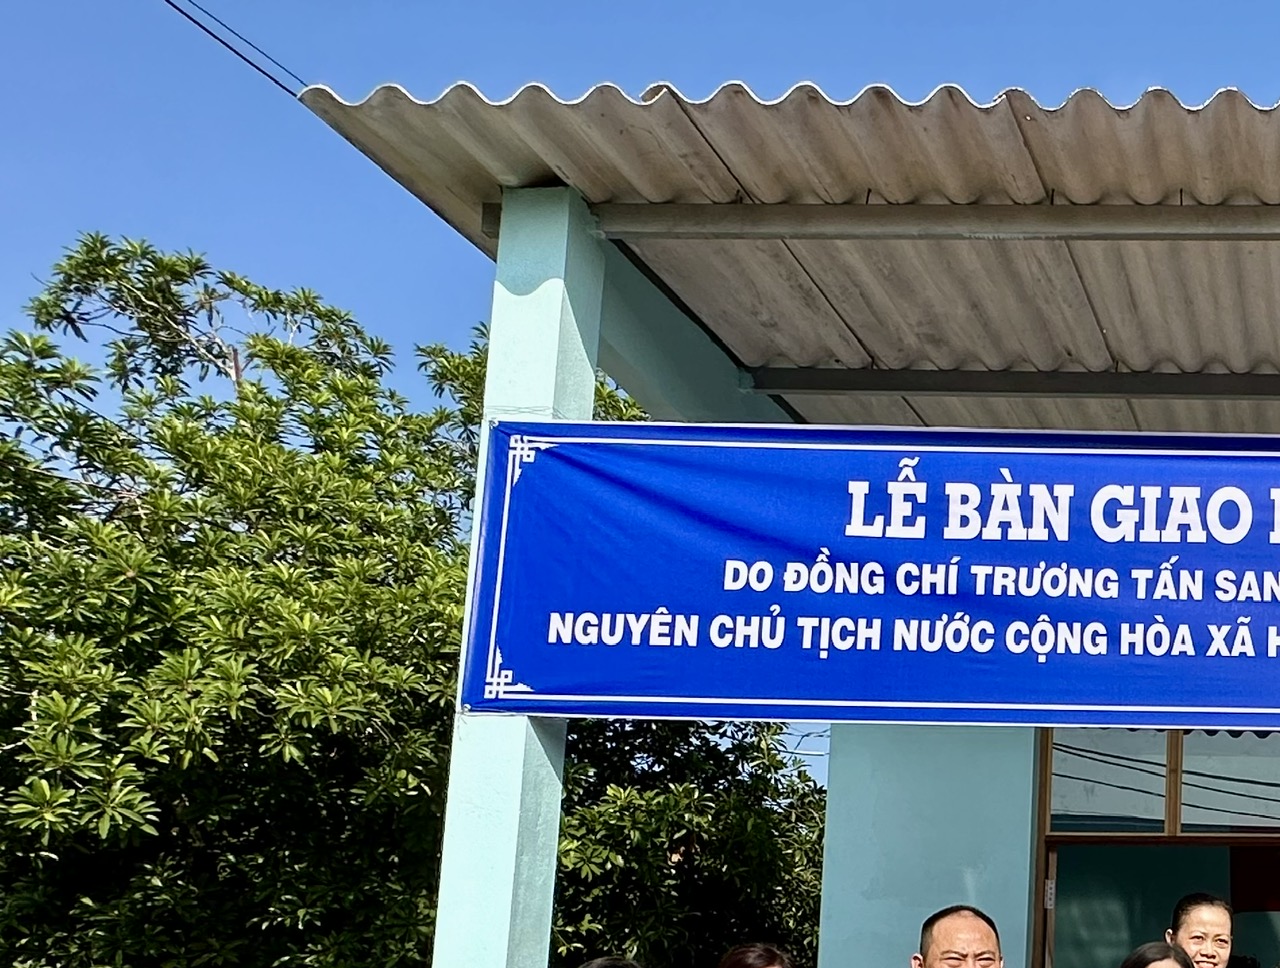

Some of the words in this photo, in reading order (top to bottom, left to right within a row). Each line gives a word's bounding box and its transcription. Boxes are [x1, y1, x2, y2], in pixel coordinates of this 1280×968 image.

[845, 456, 928, 539] LỄ
[943, 467, 1074, 542] BÀN
[1090, 484, 1254, 545] GIAO
[724, 560, 773, 592] DO
[783, 547, 886, 596] ĐỒNG
[896, 556, 960, 596] CHÍ
[971, 561, 1120, 599] TRƯƠNG
[1131, 555, 1205, 601] TẤN
[548, 607, 700, 647] NGUYÊN
[710, 604, 787, 649] CHỦ
[797, 617, 881, 659] TỊCH
[893, 611, 998, 653] NƯỚC
[1006, 614, 1108, 663] CỘNG
[1119, 615, 1196, 657] HÒA
[1205, 615, 1258, 660] XÃ
